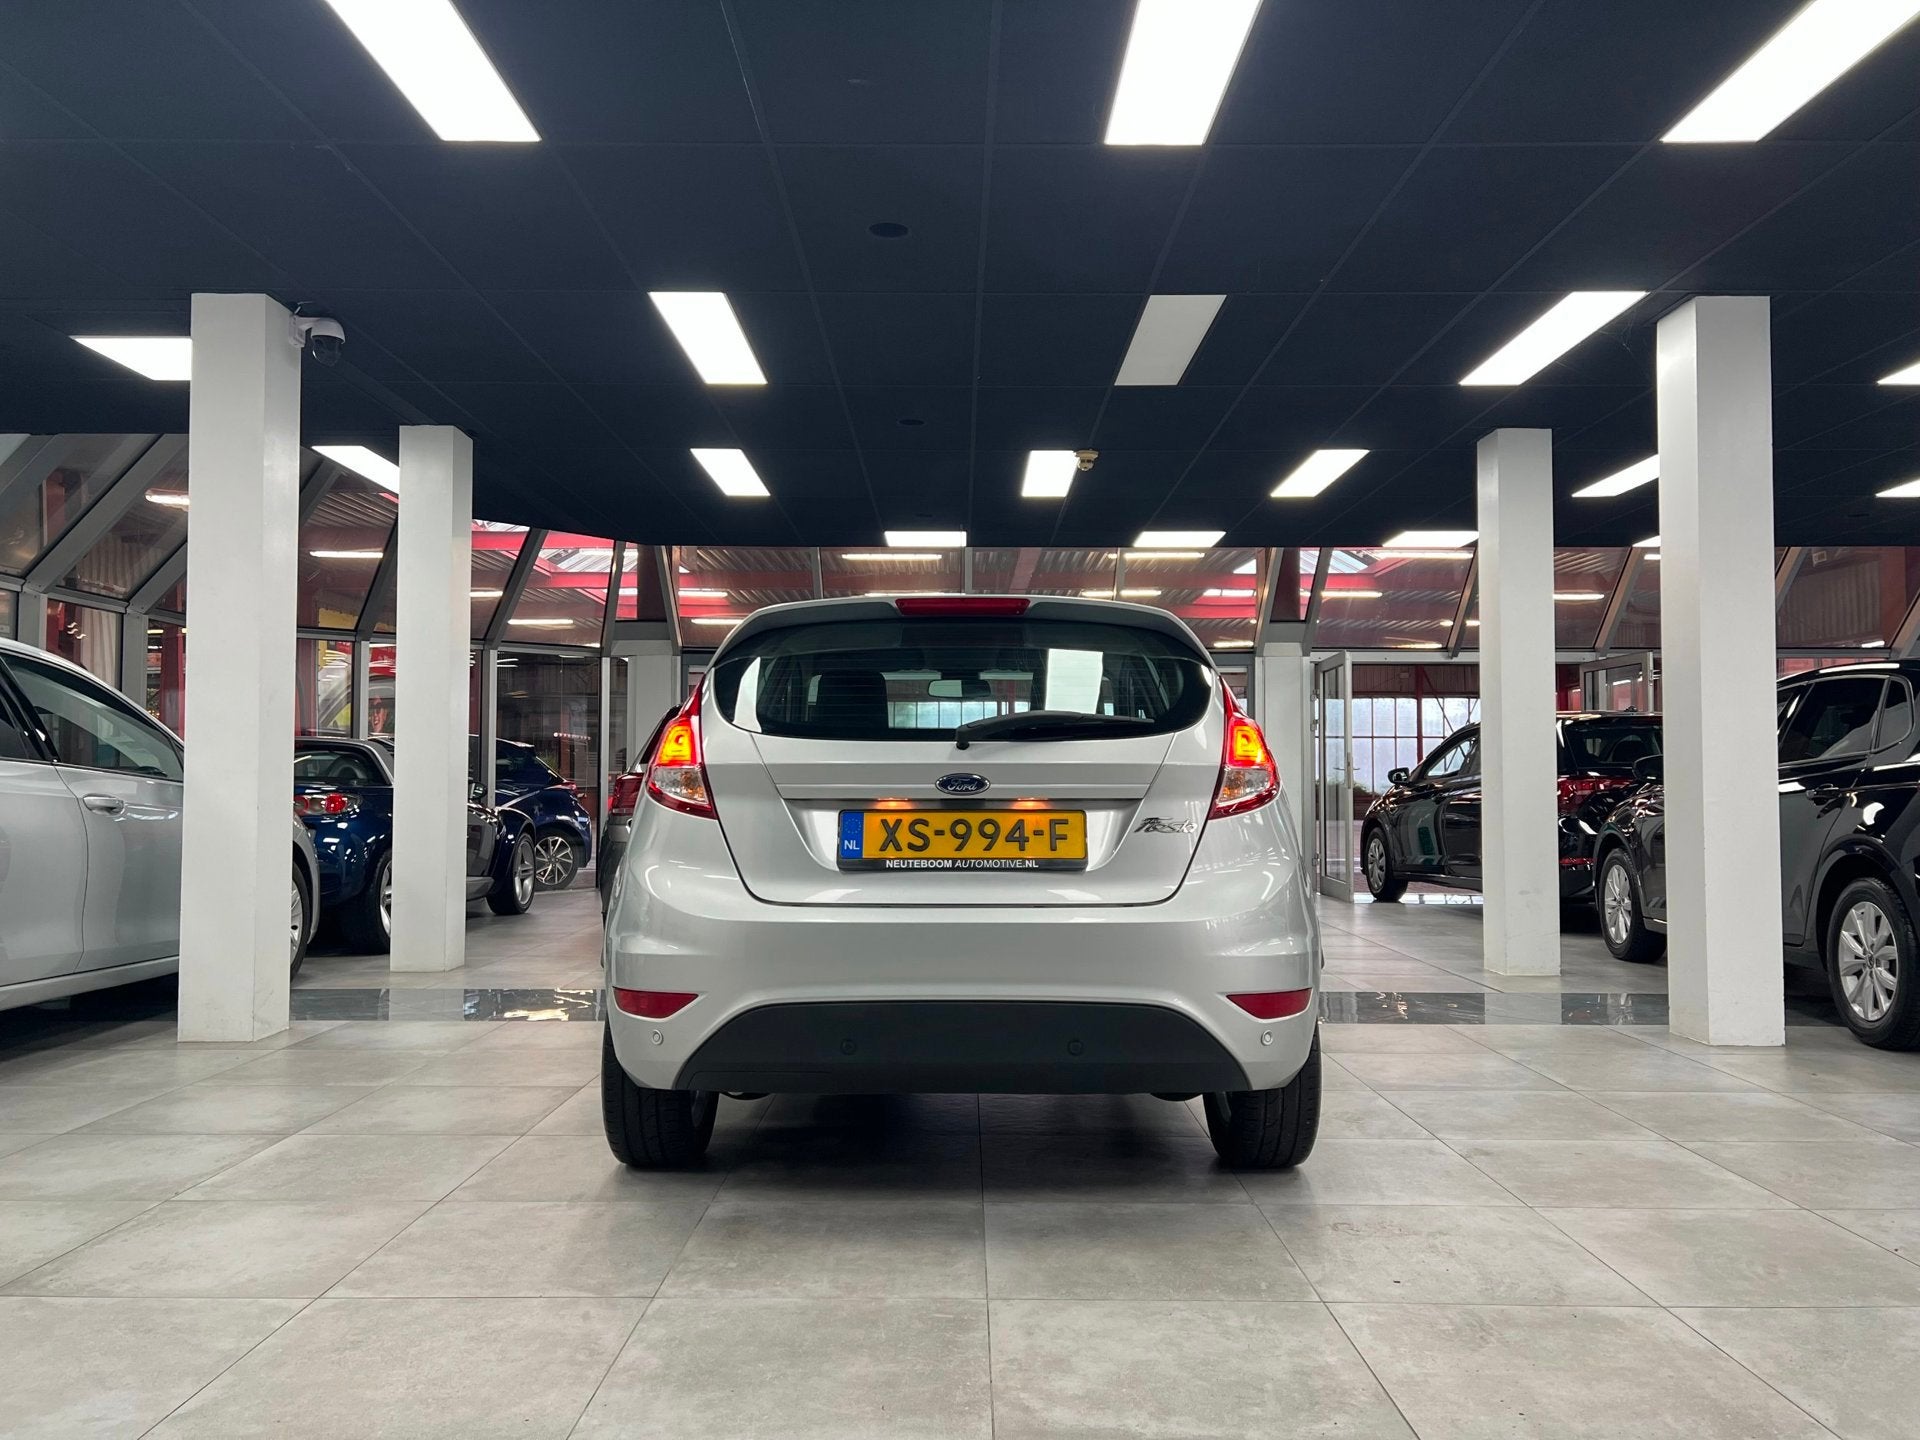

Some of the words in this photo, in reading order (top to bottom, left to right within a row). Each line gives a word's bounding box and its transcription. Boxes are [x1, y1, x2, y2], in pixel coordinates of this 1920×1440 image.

[947, 778, 977, 791] Ford
[879, 818, 1069, 852] XS-994-F
[844, 840, 860, 850] NL
[886, 859, 952, 868] NEUTEBOOM
[954, 859, 1039, 868] AUTOMOTIVE.NL
